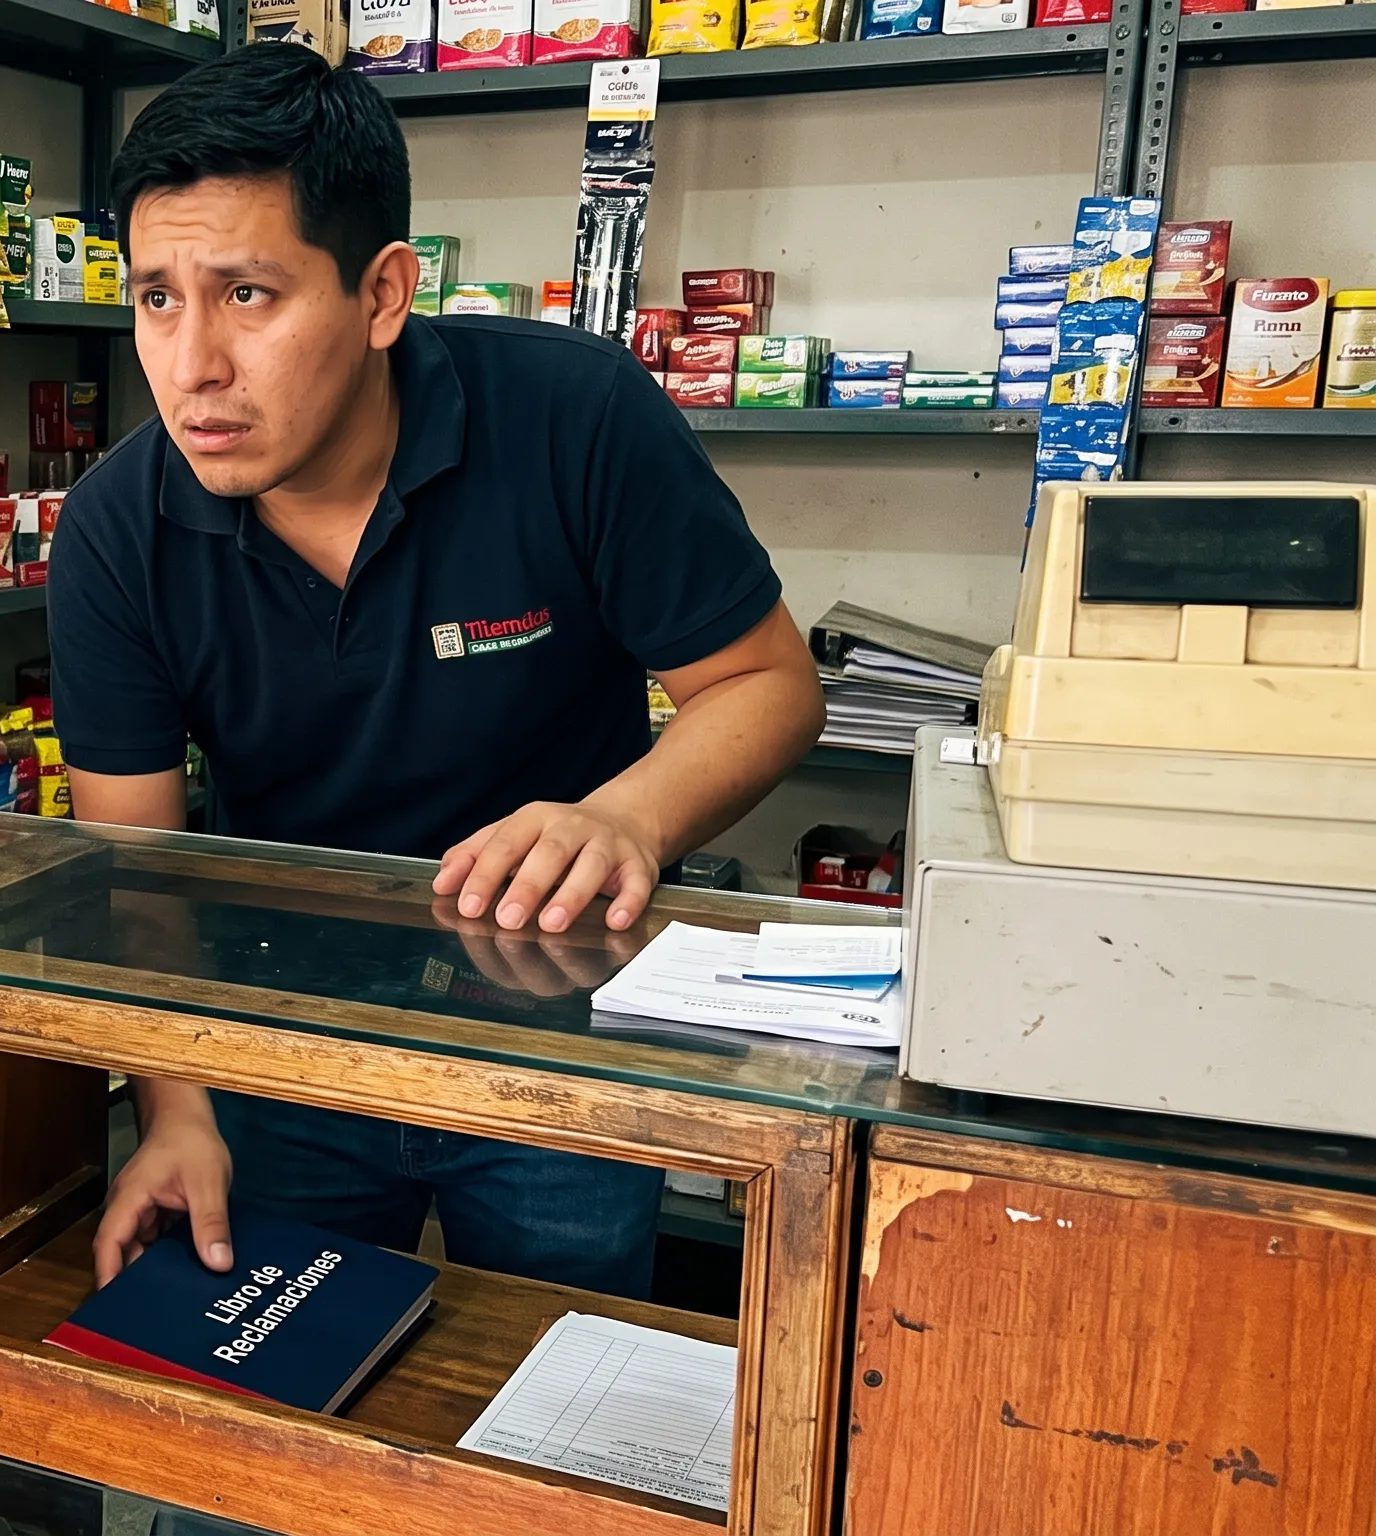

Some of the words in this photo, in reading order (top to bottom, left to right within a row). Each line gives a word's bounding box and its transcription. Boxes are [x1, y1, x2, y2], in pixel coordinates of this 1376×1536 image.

[204, 1284, 263, 1325] Libro
[249, 1265, 284, 1286] de
[212, 1250, 343, 1365] Reclamaciones
